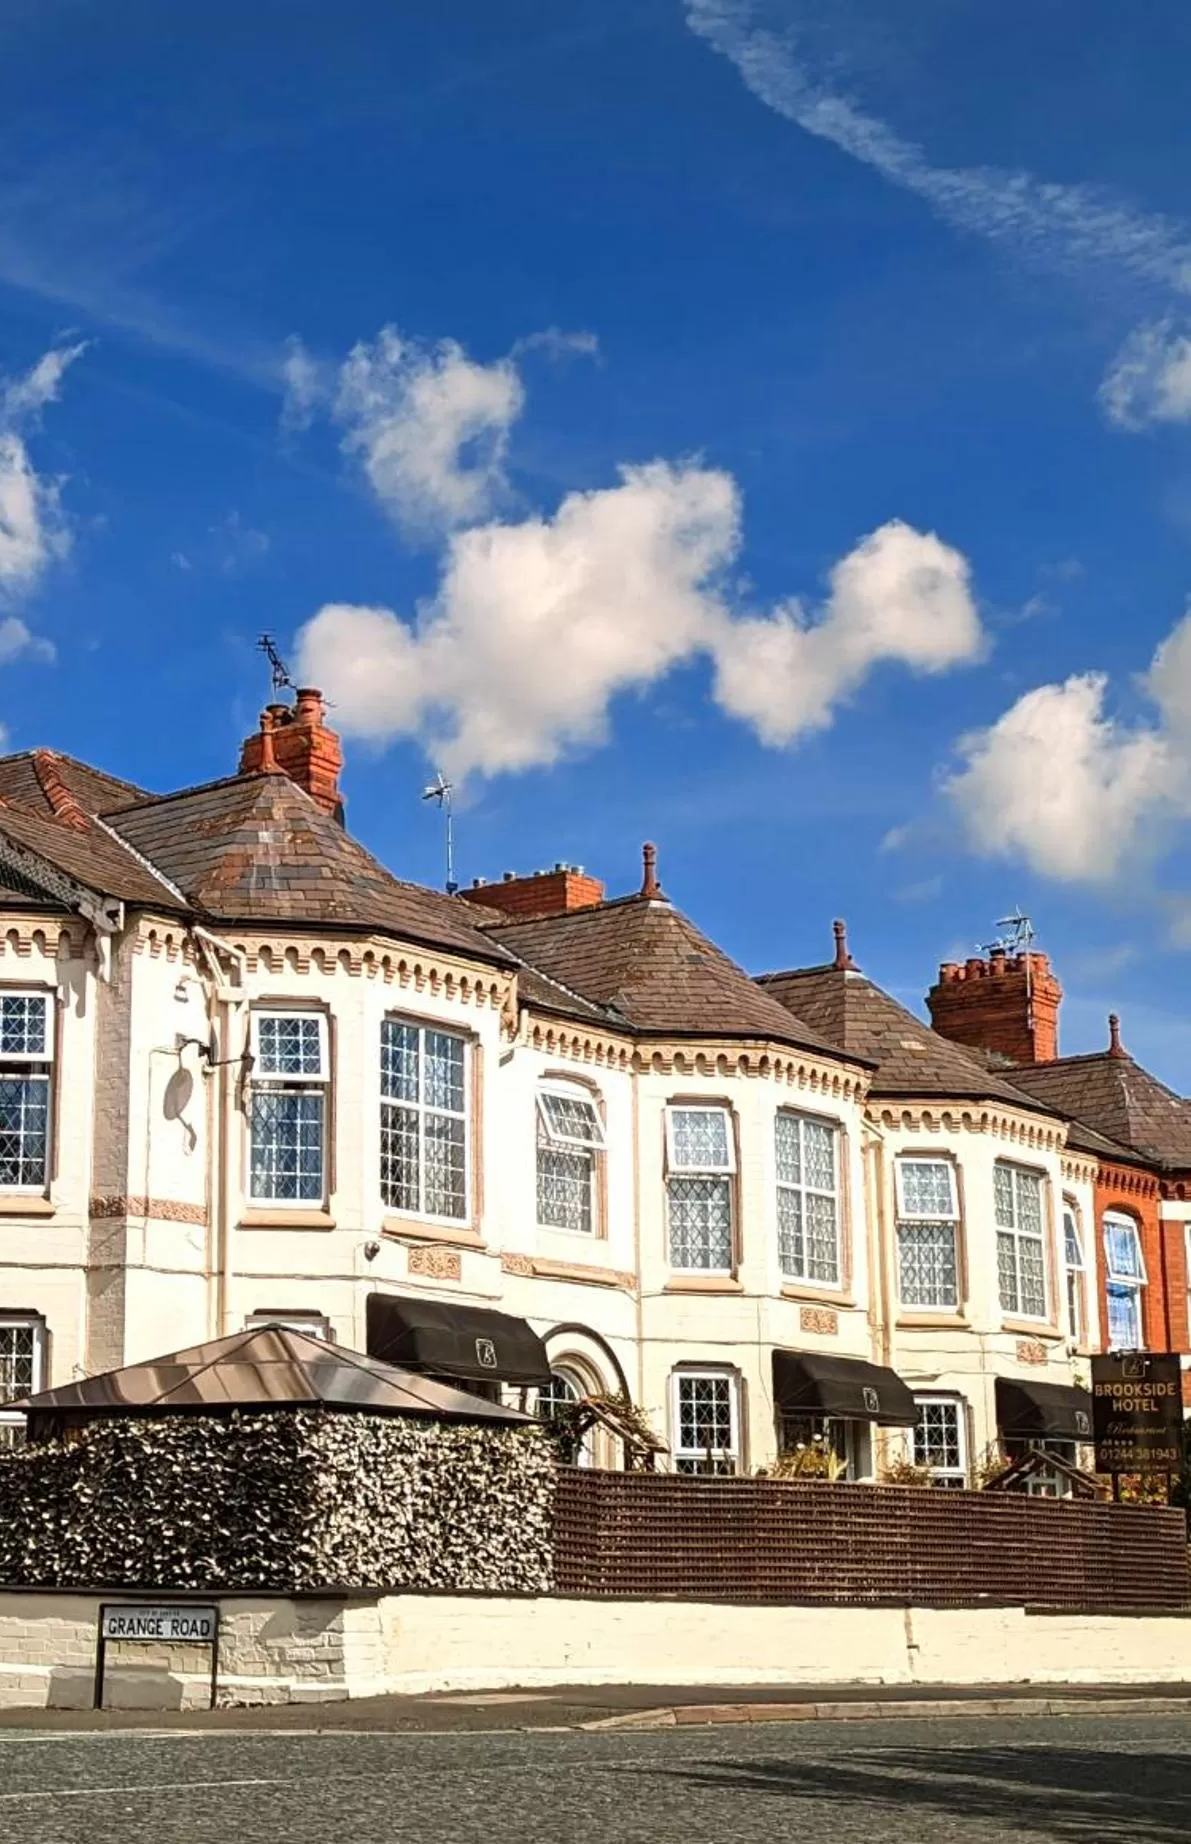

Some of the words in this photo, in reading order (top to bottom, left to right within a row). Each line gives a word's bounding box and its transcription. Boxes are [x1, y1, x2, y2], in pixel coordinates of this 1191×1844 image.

[1094, 1382, 1177, 1397] BROOKSIDE
[1112, 1399, 1159, 1412] HOTEL
[108, 1617, 164, 1635] GRANGE
[170, 1619, 210, 1636] ROAD
